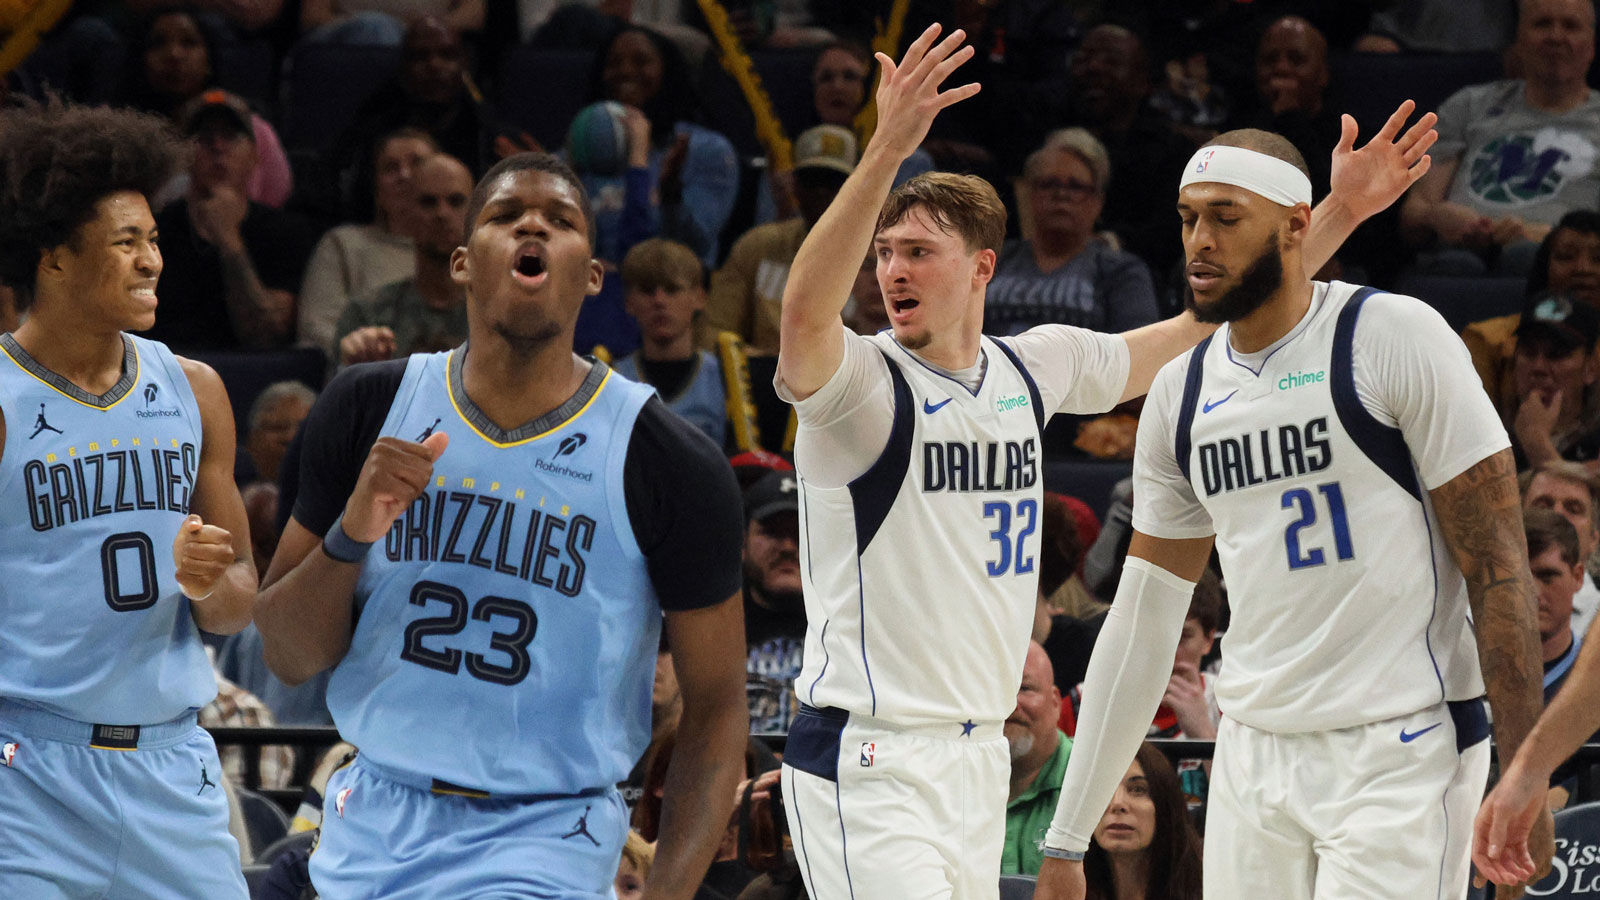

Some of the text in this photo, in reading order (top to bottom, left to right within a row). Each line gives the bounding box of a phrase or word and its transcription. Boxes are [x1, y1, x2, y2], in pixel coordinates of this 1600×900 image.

[1278, 370, 1325, 391] chime
[136, 409, 181, 419] Robinhood
[46, 438, 179, 463] MEMPHIS
[534, 459, 593, 482] Robinhood
[922, 436, 1038, 493] DALLAS
[1198, 415, 1333, 499] DALLAS
[23, 442, 196, 532] GRIZZLIES
[436, 476, 570, 517] EMPHIS
[982, 498, 1038, 578] 32
[1281, 480, 1356, 572] 21
[101, 531, 159, 612] 0
[400, 579, 538, 686] 23
[1525, 838, 1600, 896] Sis
